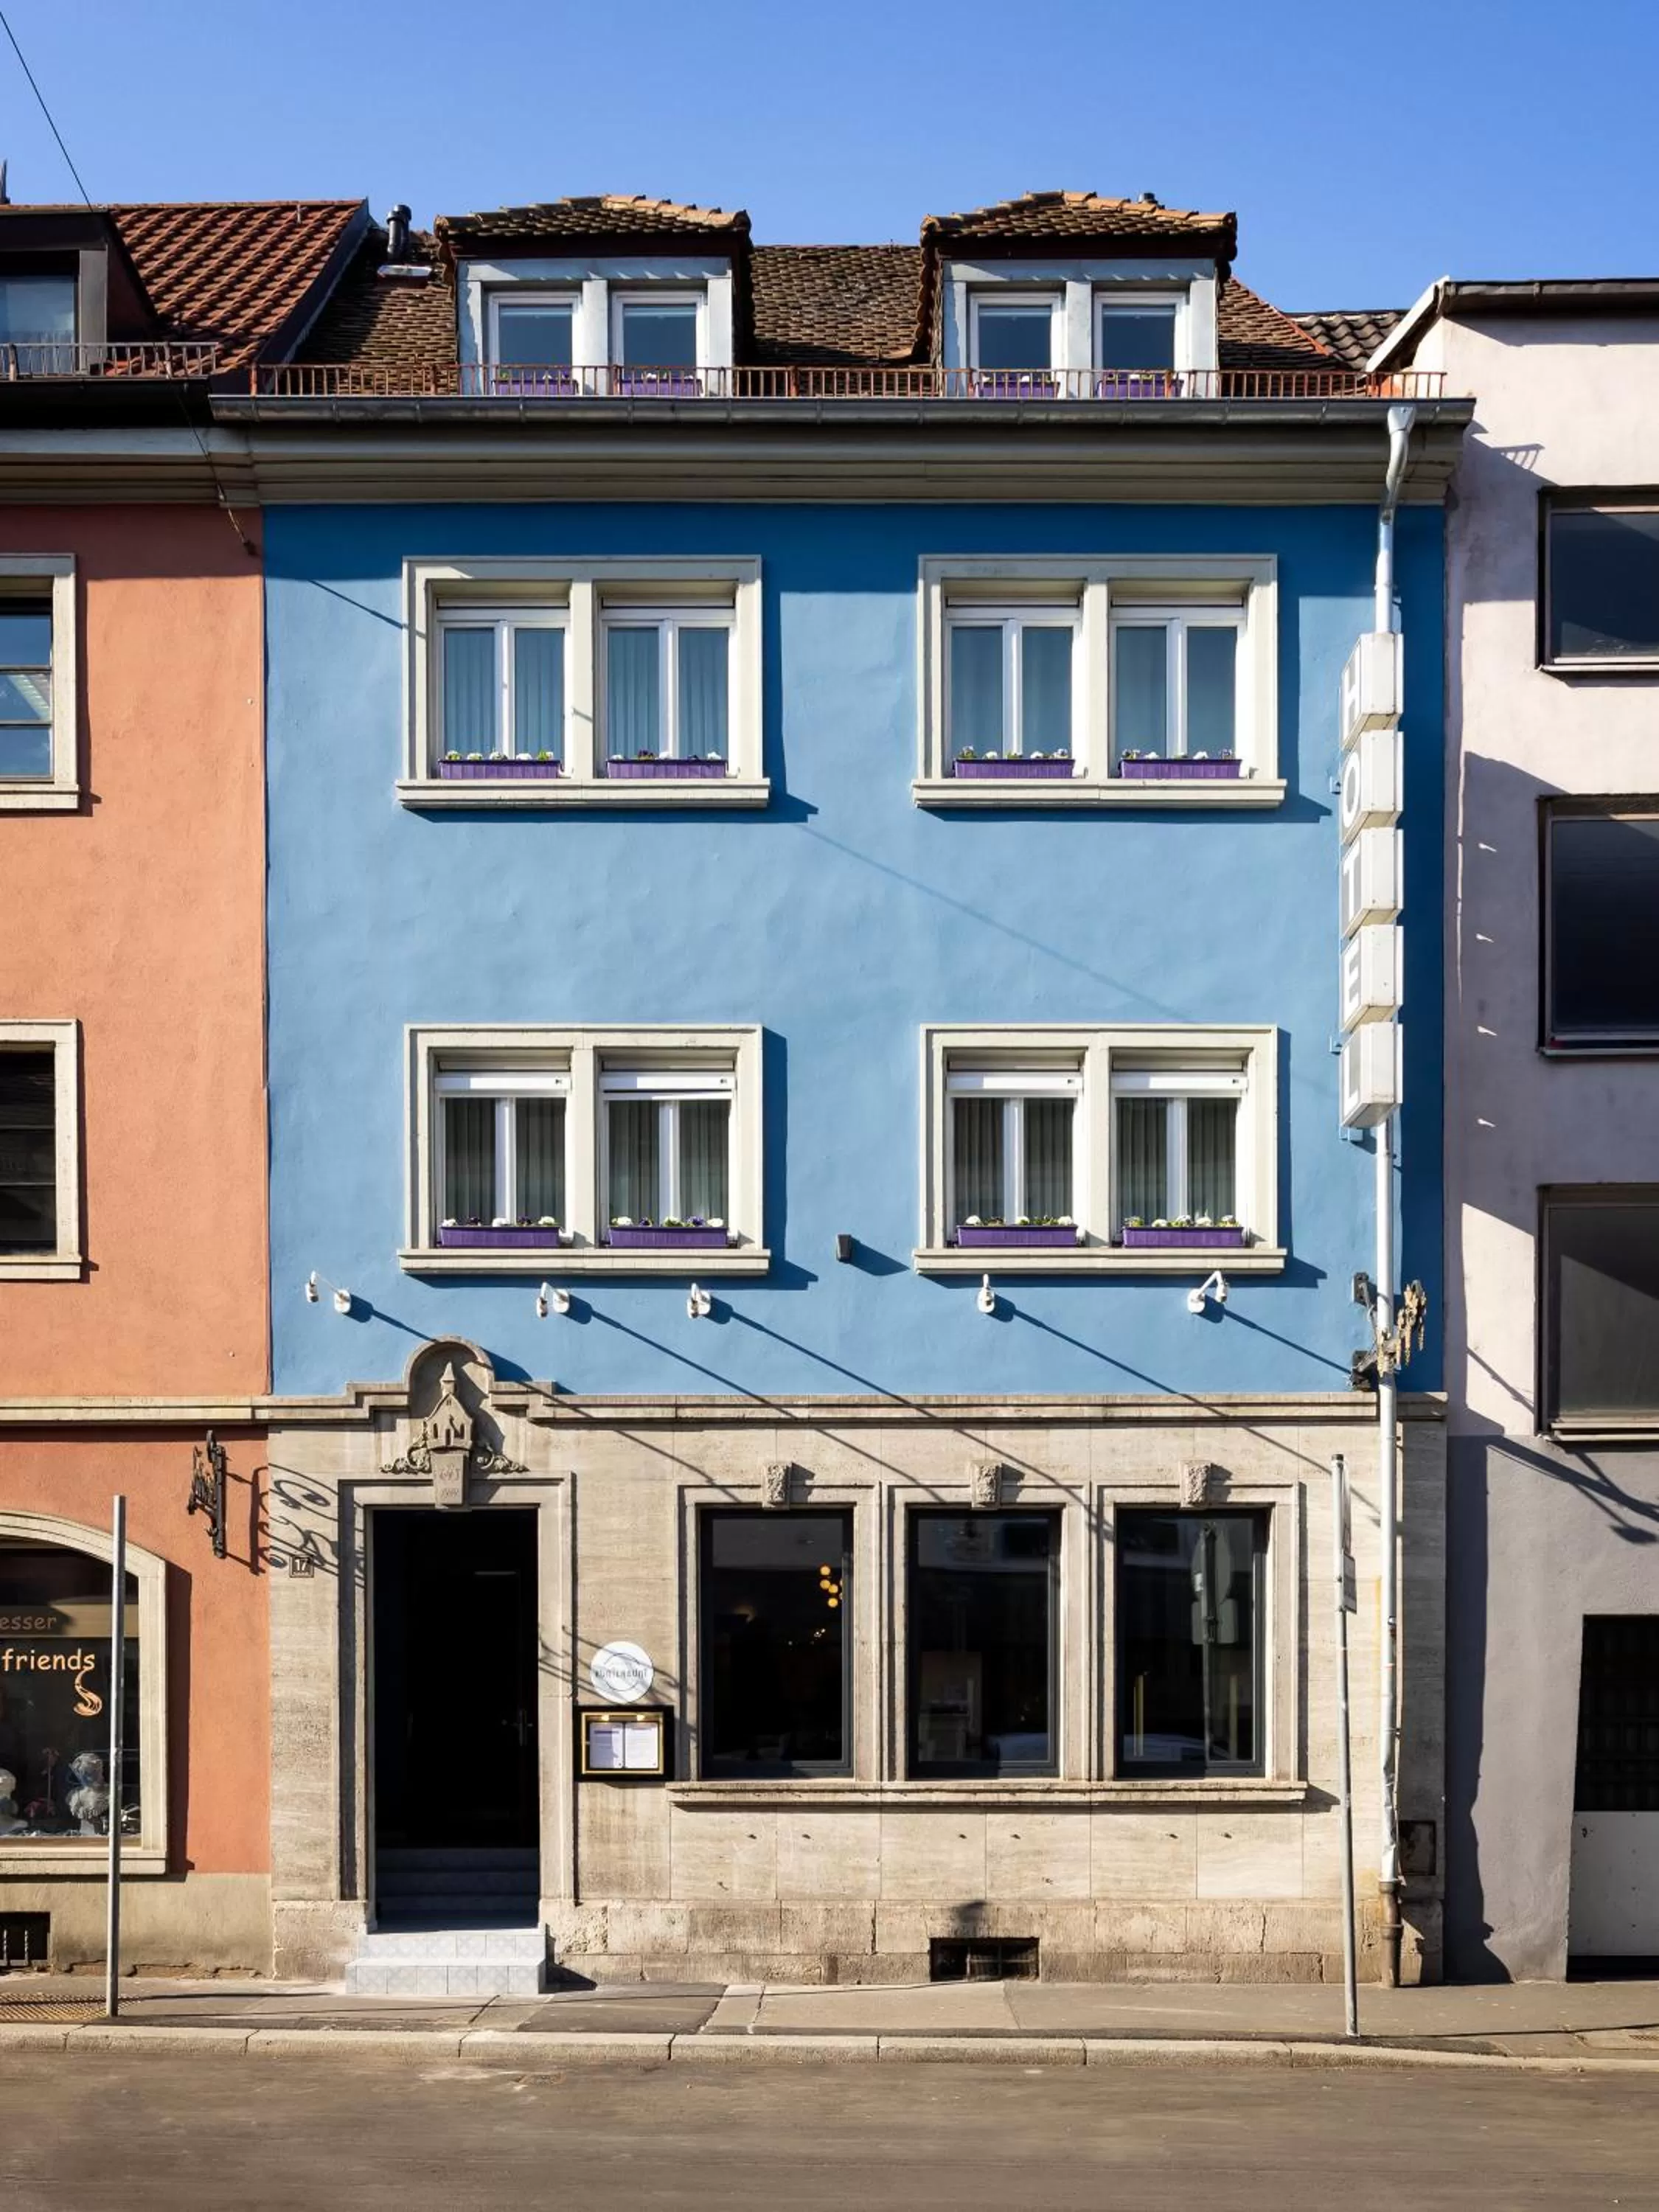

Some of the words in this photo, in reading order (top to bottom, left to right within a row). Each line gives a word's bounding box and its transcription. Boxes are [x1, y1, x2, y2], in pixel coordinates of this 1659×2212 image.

[1341, 641, 1360, 1116] HOTEL
[294, 1558, 308, 1571] 17
[1, 1647, 95, 1672] friends
